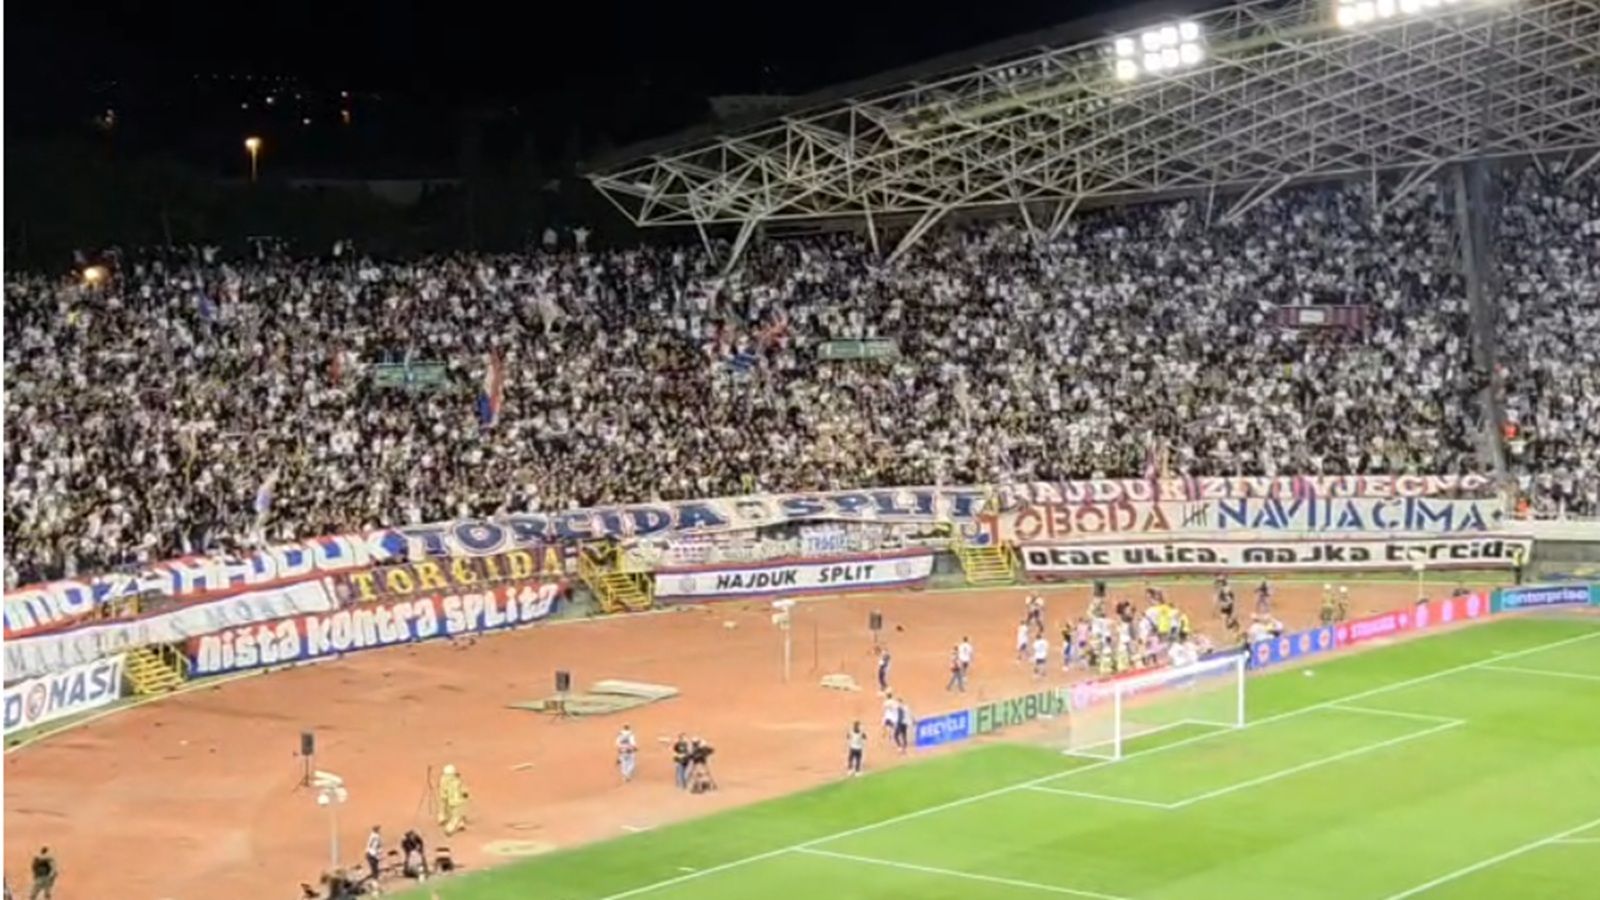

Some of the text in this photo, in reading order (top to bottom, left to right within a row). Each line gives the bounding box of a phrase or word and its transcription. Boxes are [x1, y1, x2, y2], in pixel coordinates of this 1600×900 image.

[350, 544, 564, 600] TORCIDA
[716, 565, 875, 590] HAJDUK SPLIT
